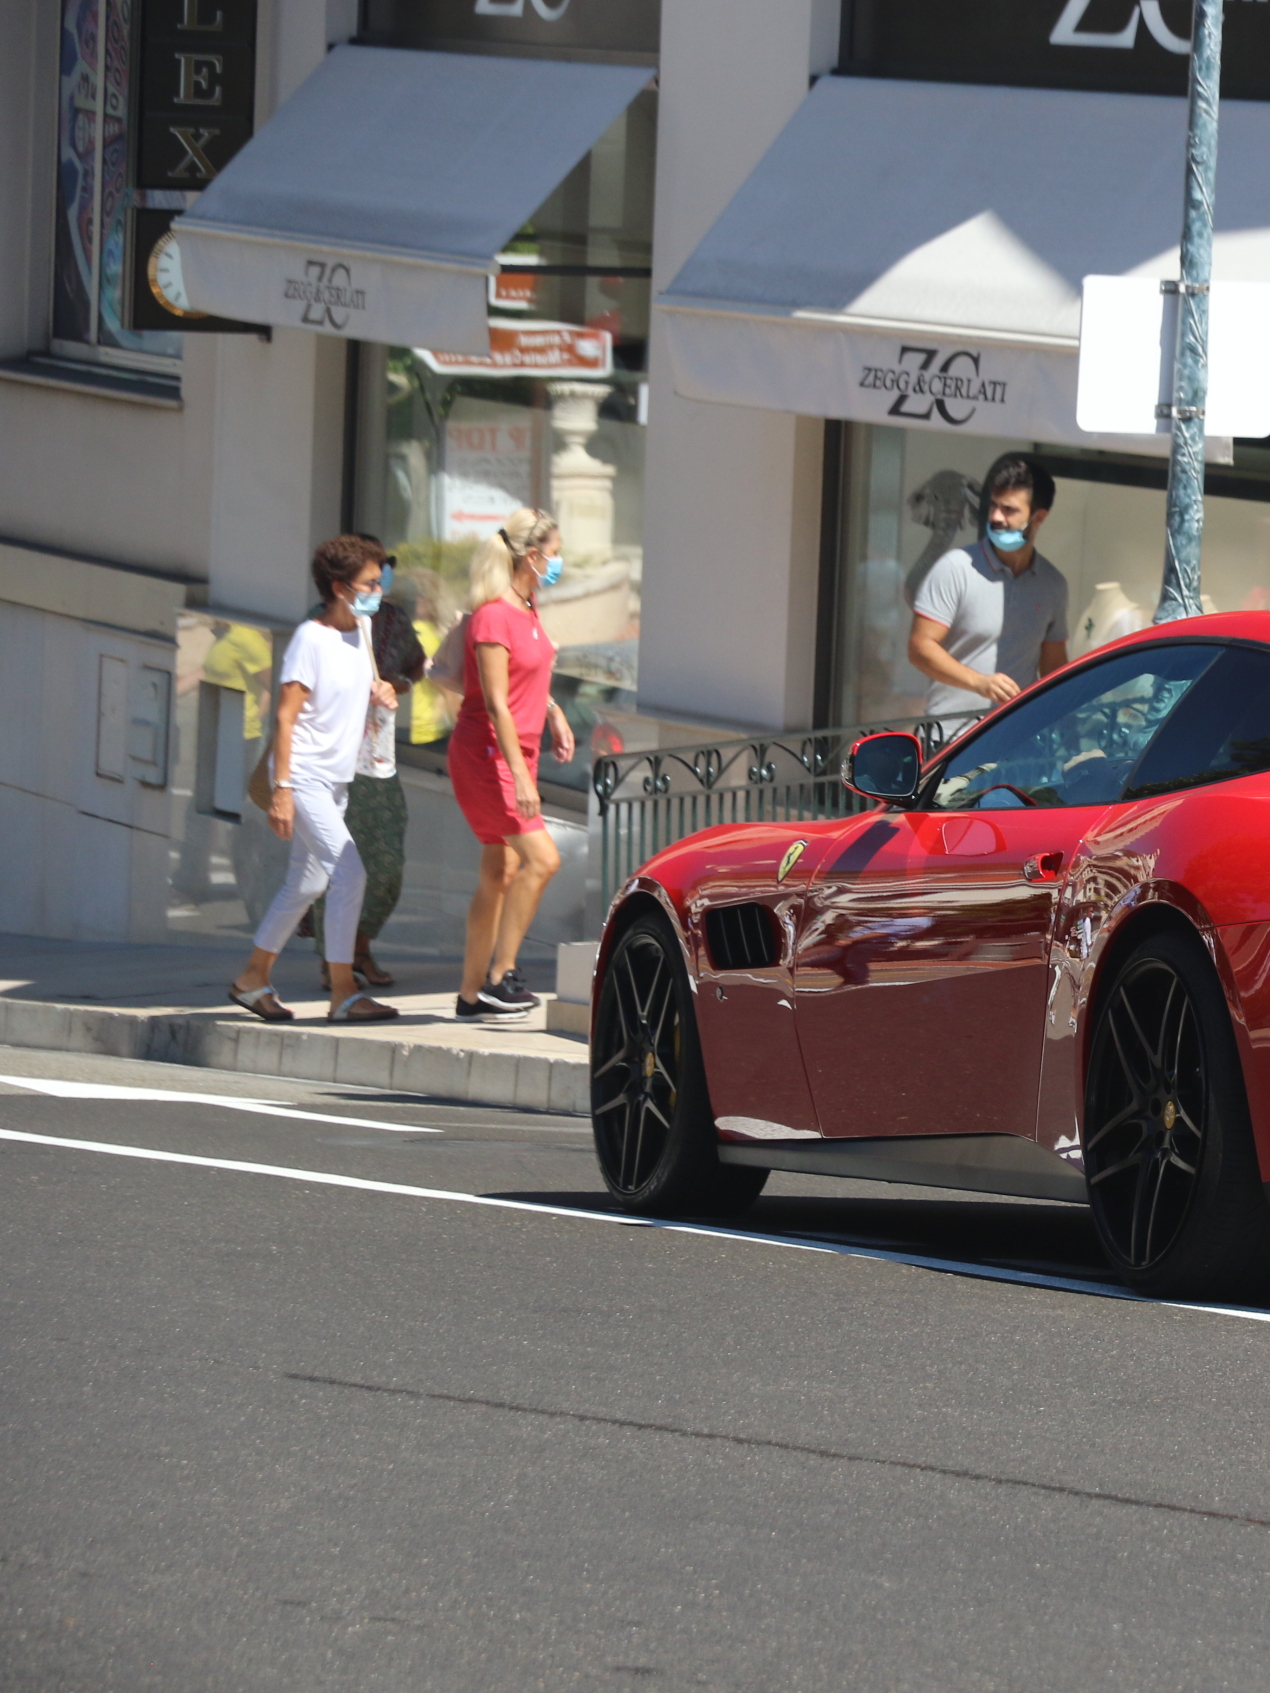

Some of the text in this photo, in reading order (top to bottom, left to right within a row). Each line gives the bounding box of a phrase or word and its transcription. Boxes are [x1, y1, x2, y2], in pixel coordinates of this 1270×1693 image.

[859, 365, 910, 394] ZEGG
[928, 374, 1008, 404] CERLATI
[887, 345, 981, 427] ZC
